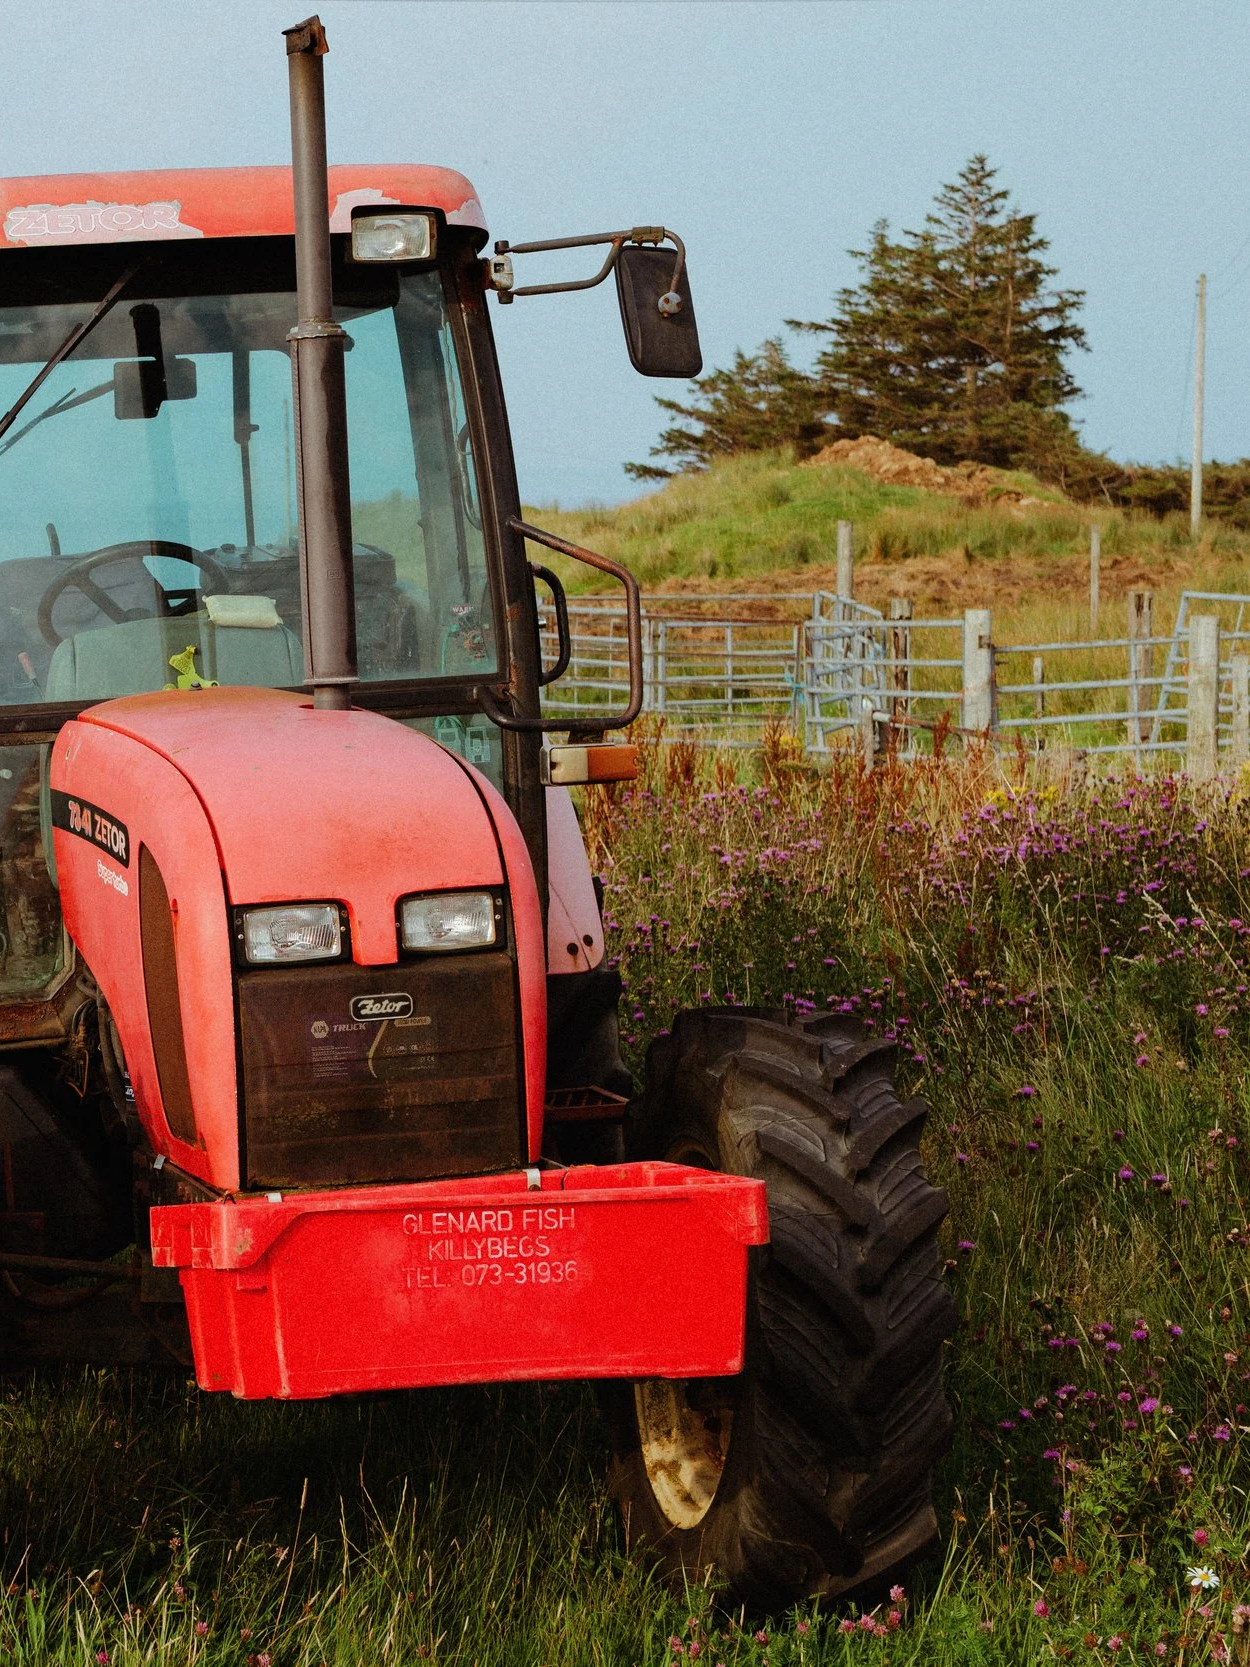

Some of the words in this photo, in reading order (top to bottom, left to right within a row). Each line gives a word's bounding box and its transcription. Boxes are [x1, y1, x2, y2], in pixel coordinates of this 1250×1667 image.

[7, 205, 180, 237] ZETOR
[94, 813, 126, 859] ZETOR
[358, 999, 410, 1016] Zetor
[333, 1023, 366, 1032] TRUCK
[402, 1210, 514, 1235] GLENARD
[522, 1207, 575, 1231] FISH
[428, 1235, 550, 1261] KILLYBEGS
[461, 1260, 578, 1287] 073-31936
